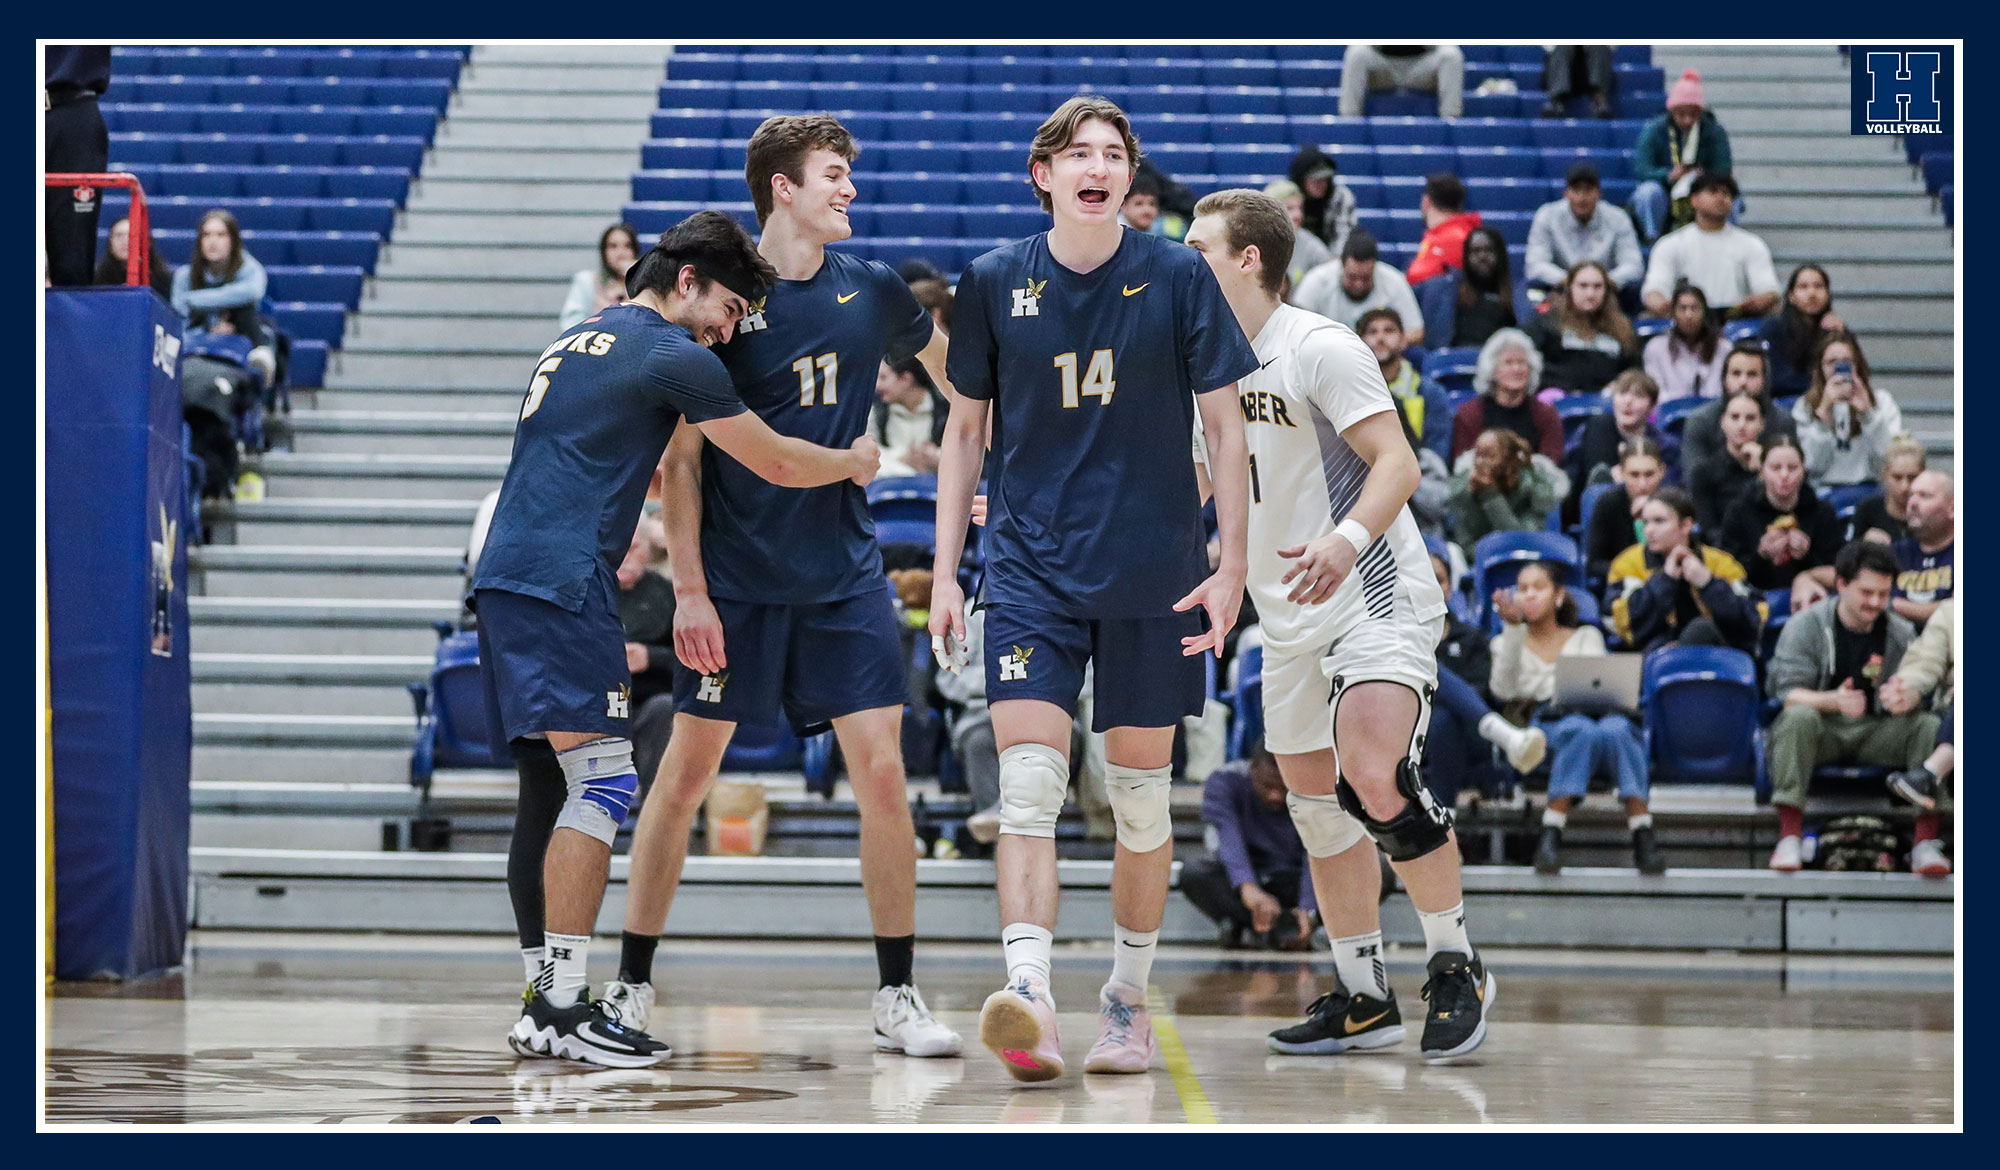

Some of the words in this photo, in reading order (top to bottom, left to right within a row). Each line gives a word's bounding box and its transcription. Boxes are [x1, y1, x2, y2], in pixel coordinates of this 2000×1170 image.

[1011, 287, 1039, 317] H
[521, 357, 563, 421] 5
[792, 352, 838, 407] 11
[1053, 348, 1117, 409] 14
[999, 653, 1028, 682] H
[696, 676, 722, 703] H
[606, 691, 629, 719] H
[551, 946, 573, 961] H
